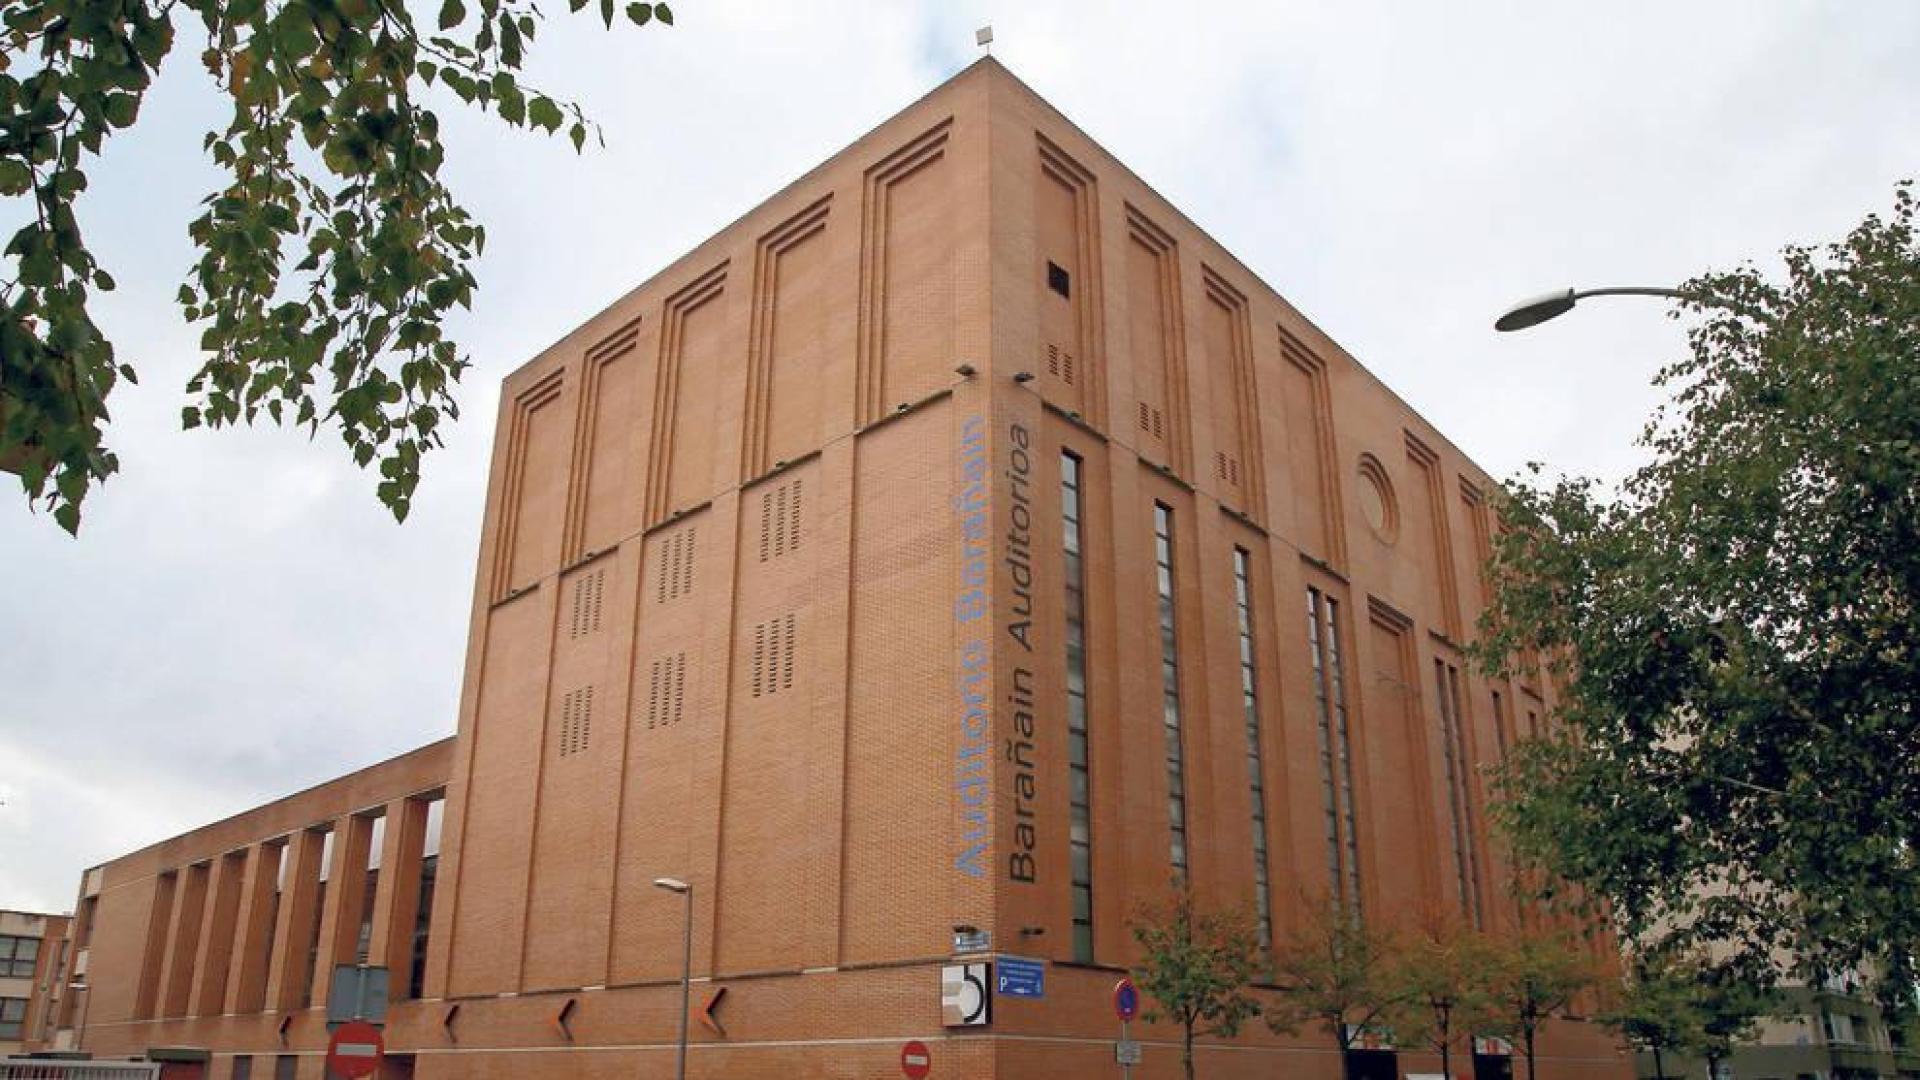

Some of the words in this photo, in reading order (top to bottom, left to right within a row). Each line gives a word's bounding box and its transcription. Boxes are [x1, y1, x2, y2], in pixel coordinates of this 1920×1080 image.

[1005, 423, 1032, 652] Auditorioa
[955, 641, 989, 878] Auditorio
[1006, 666, 1036, 884] Barañain
[1000, 976, 1008, 992] P
